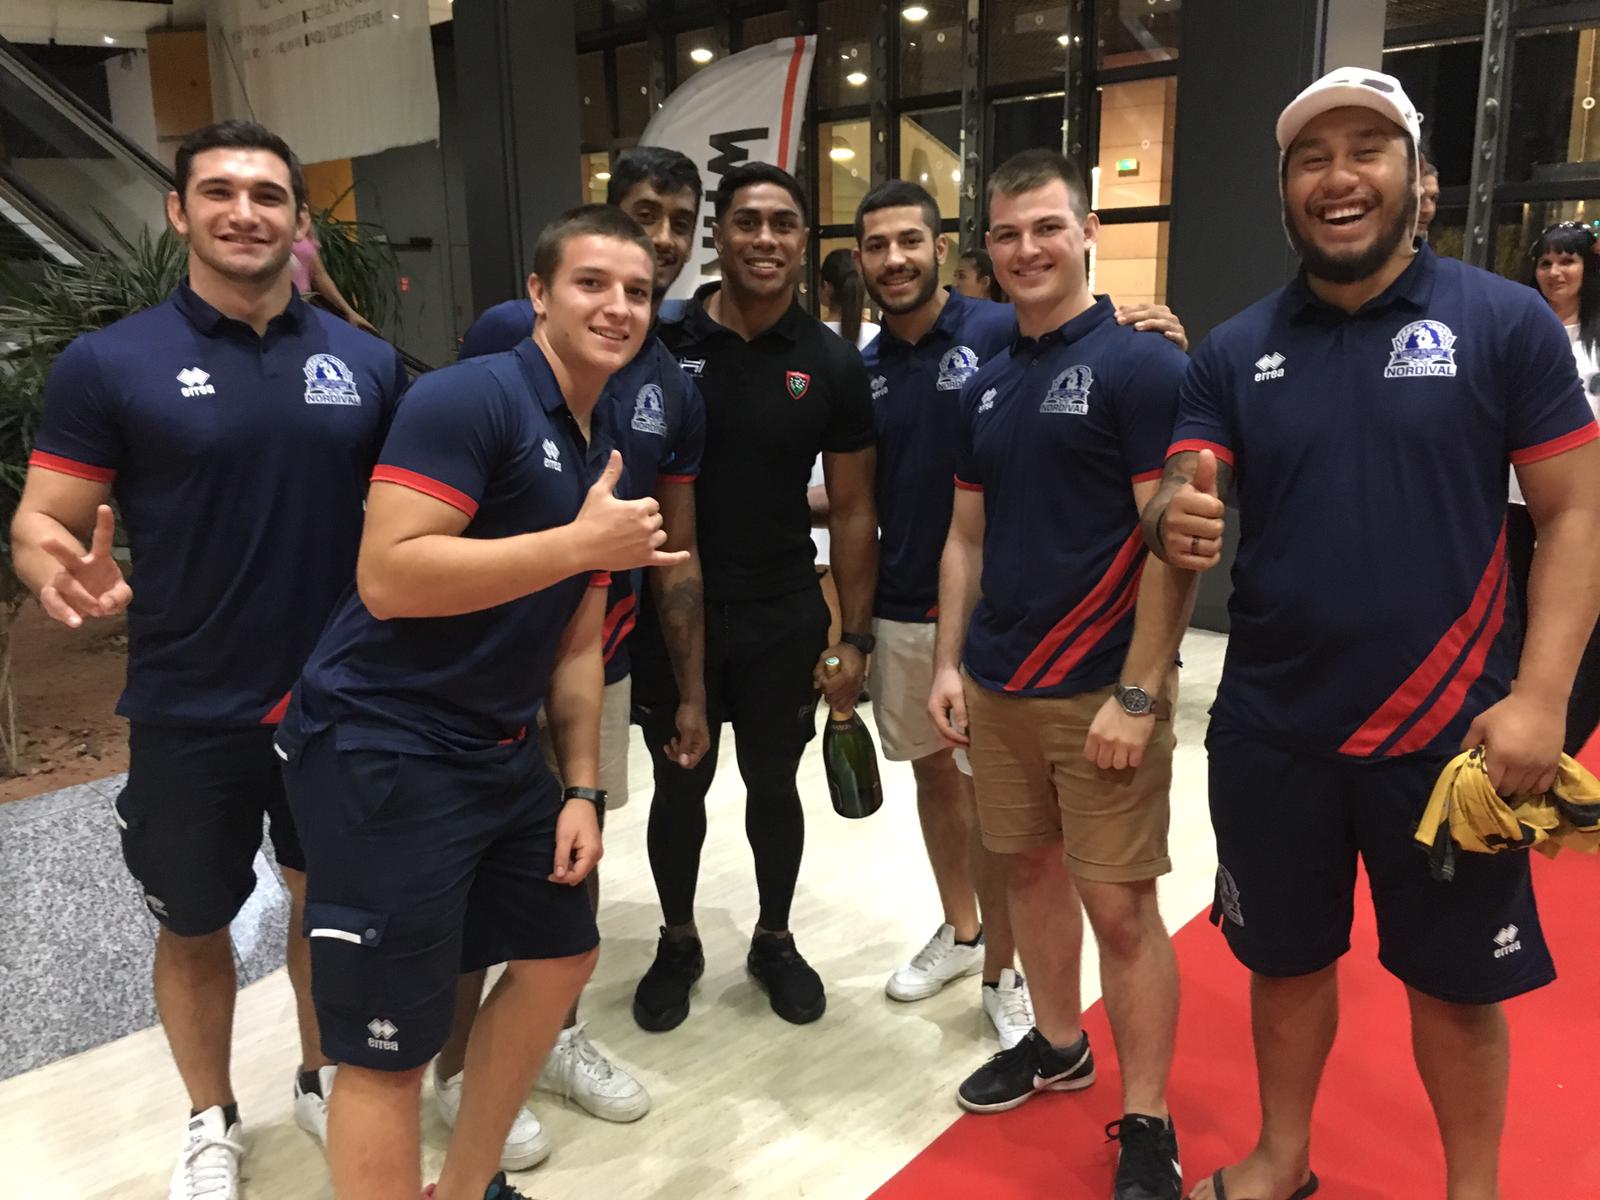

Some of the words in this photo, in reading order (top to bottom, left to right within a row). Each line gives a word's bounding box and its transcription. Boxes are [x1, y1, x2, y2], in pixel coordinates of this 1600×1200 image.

[1254, 367, 1285, 382] errea
[1386, 366, 1454, 377] NORDIVAL
[181, 384, 215, 397] errea
[306, 394, 361, 405] NORDIVAL
[1040, 403, 1088, 414] NORDIVAL
[1494, 940, 1521, 958] errea
[368, 1037, 399, 1051] errea
